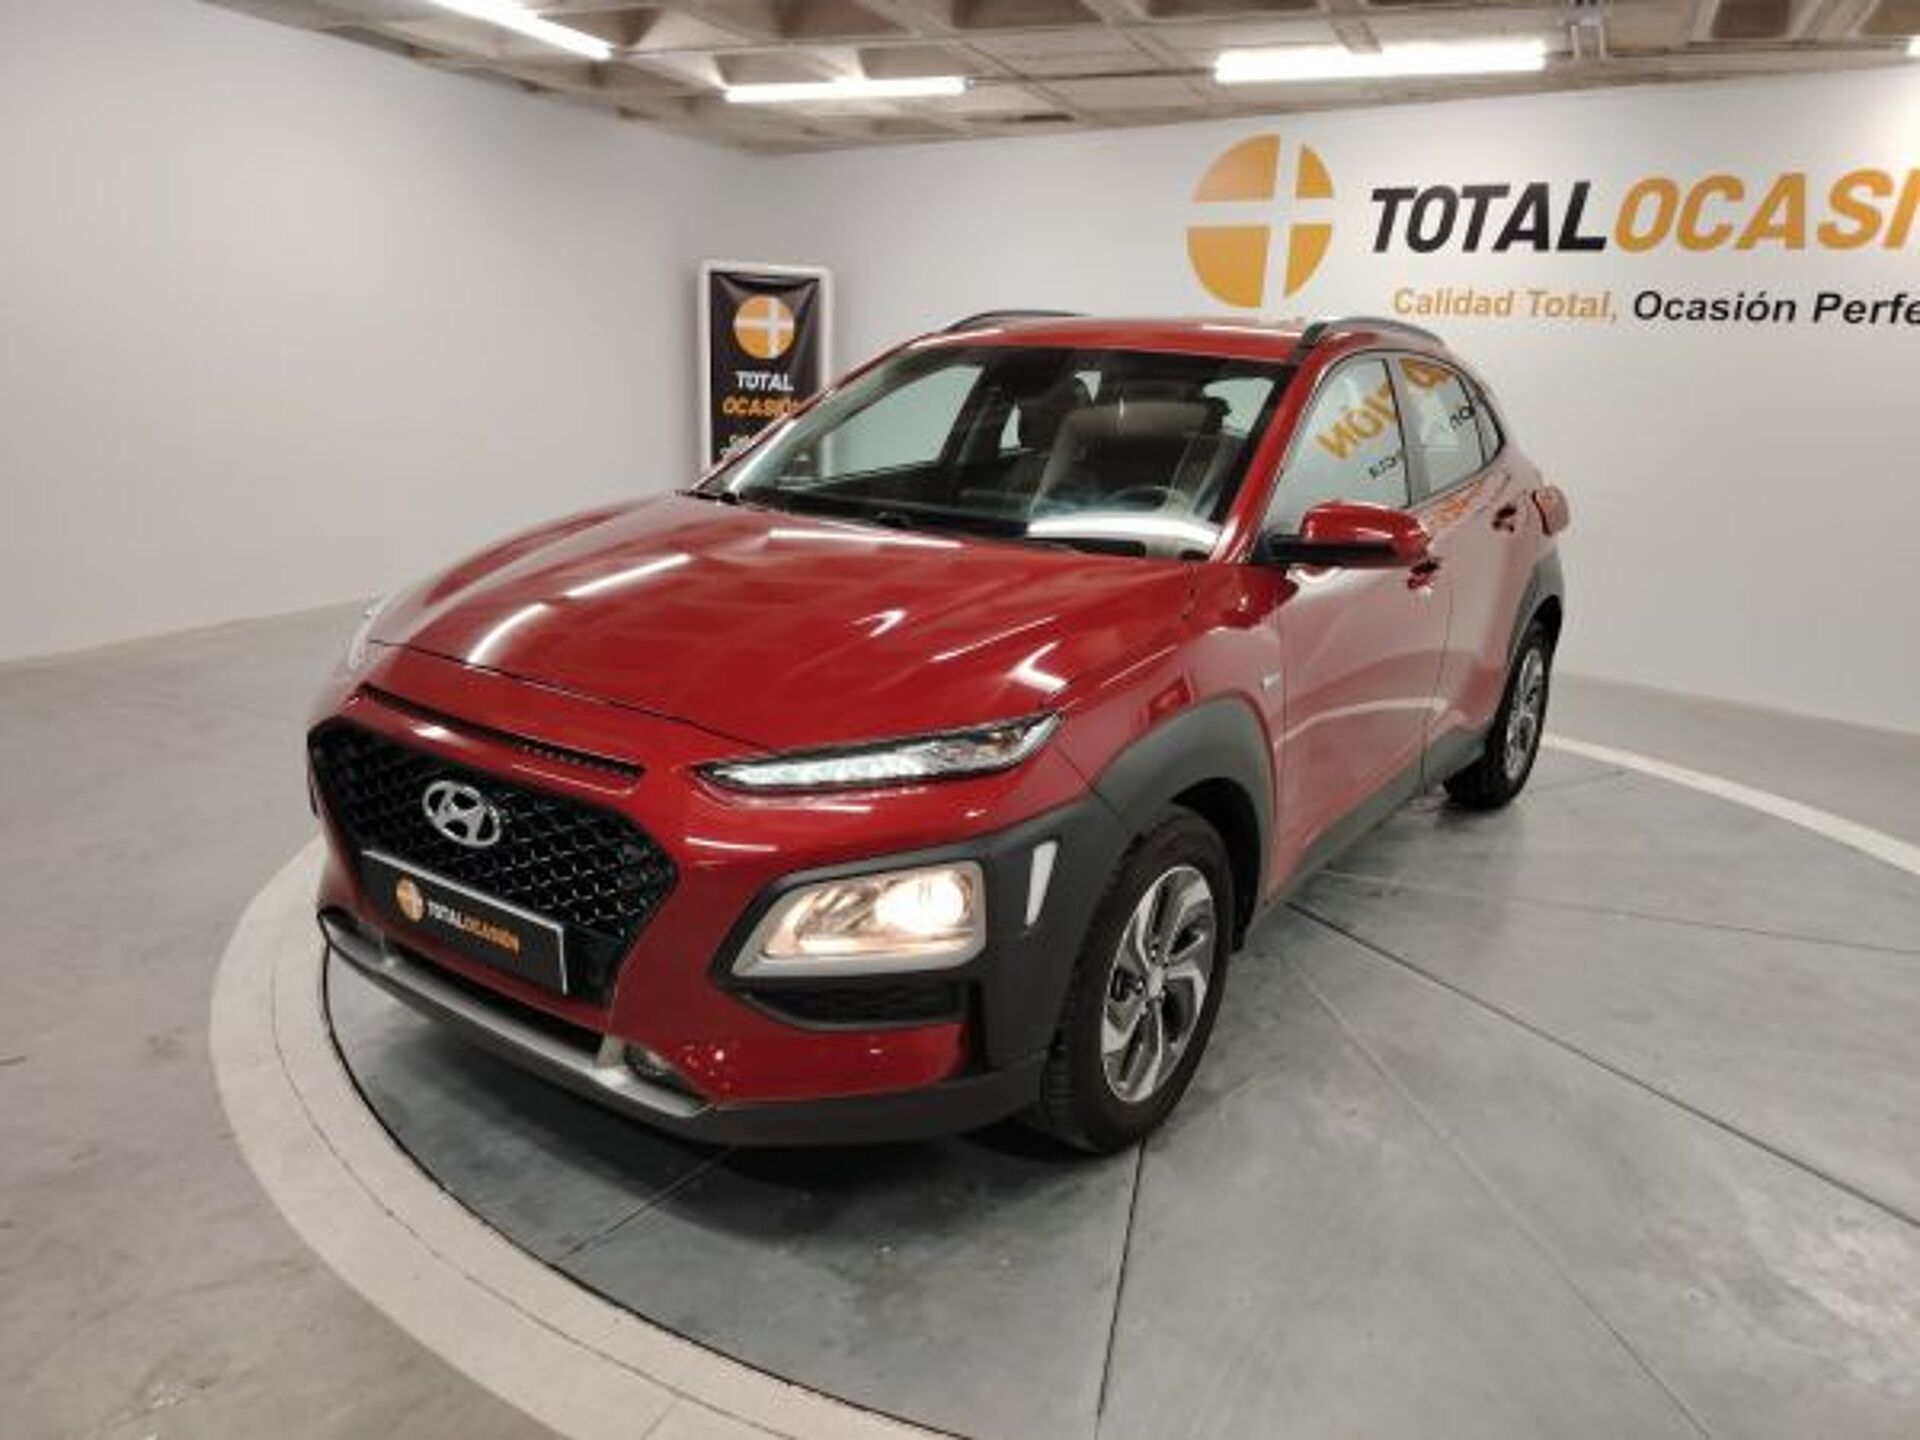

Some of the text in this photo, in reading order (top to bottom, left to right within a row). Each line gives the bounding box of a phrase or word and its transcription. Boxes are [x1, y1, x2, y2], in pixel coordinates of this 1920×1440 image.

[1394, 287, 1514, 317] Calidad
[1526, 290, 1617, 322] Total,
[1633, 290, 1797, 323] Ocasión
[736, 370, 795, 391] TOTAL
